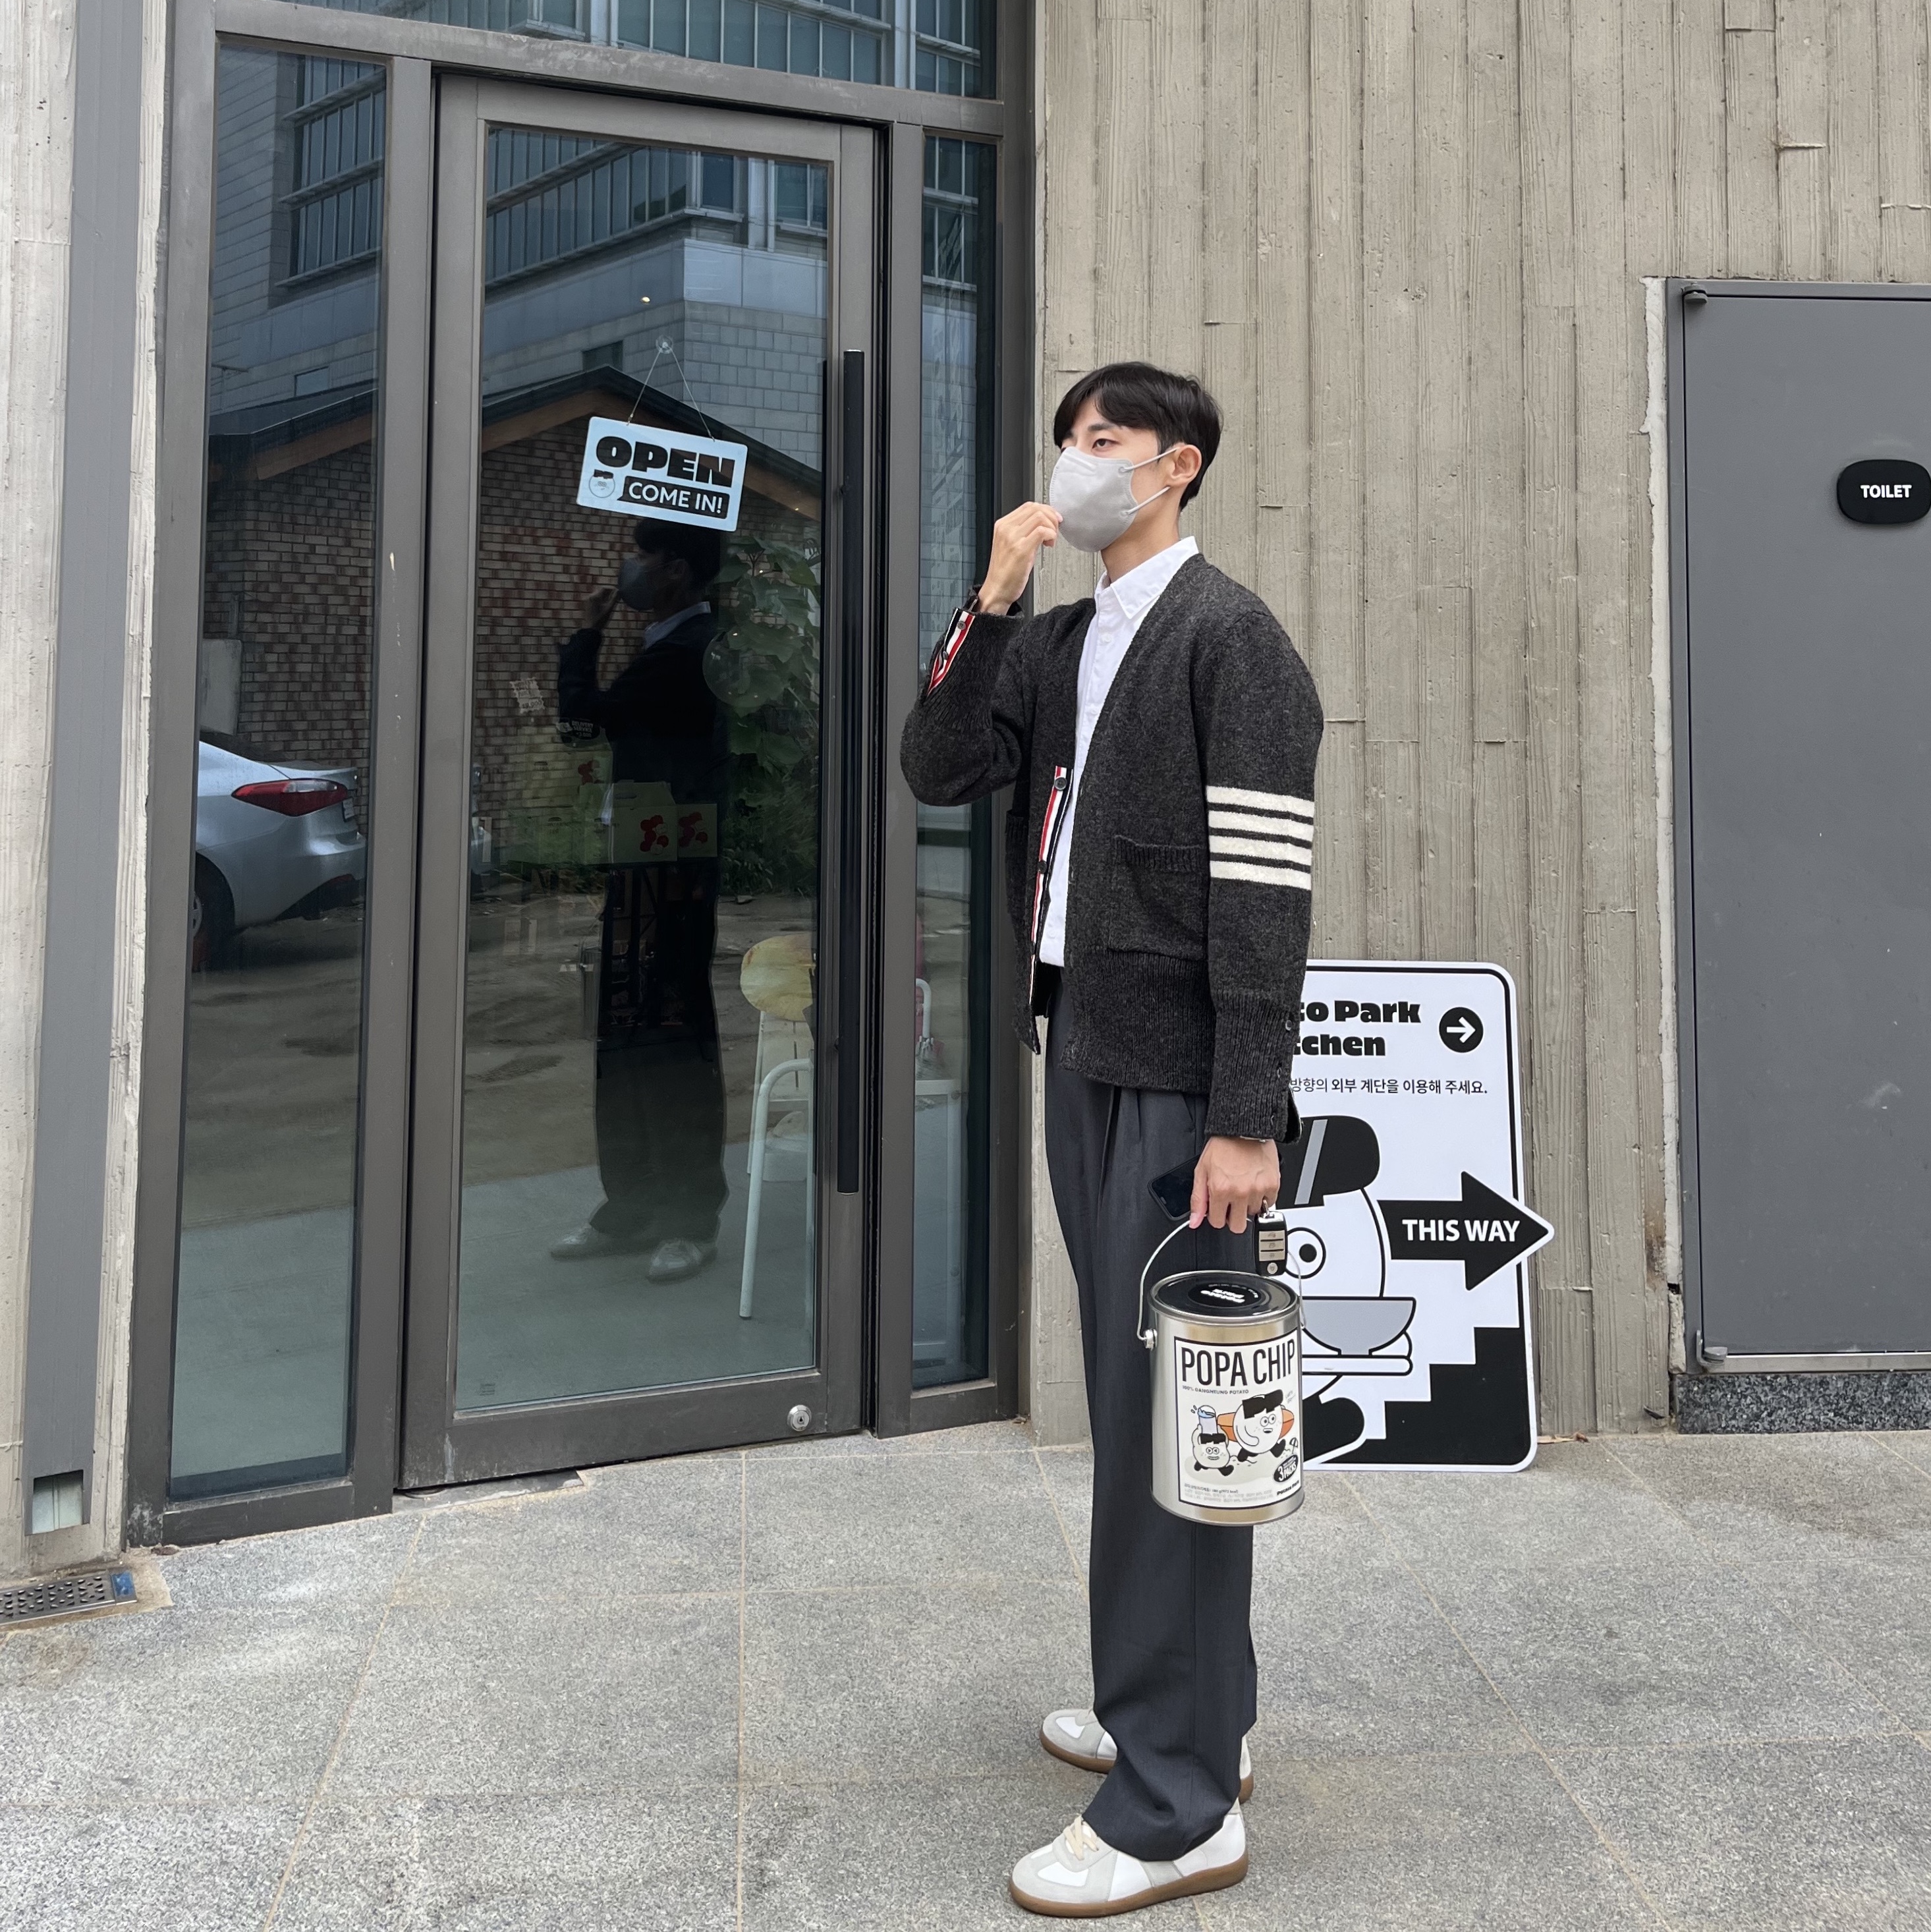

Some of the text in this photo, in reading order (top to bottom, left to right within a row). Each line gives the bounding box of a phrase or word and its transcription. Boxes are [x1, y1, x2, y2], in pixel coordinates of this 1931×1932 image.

[596, 436, 735, 488] OPEN
[629, 482, 723, 514] COME IN!
[1860, 484, 1912, 498] TOILET
[1334, 1000, 1422, 1023] Park
[1291, 1077, 1488, 1094] 방향의 외부 계단을 이용해 주세요.
[1402, 1218, 1520, 1242] THIS WAY
[1181, 1338, 1295, 1386] POPA CHIP
[1277, 1465, 1284, 1481] 3
